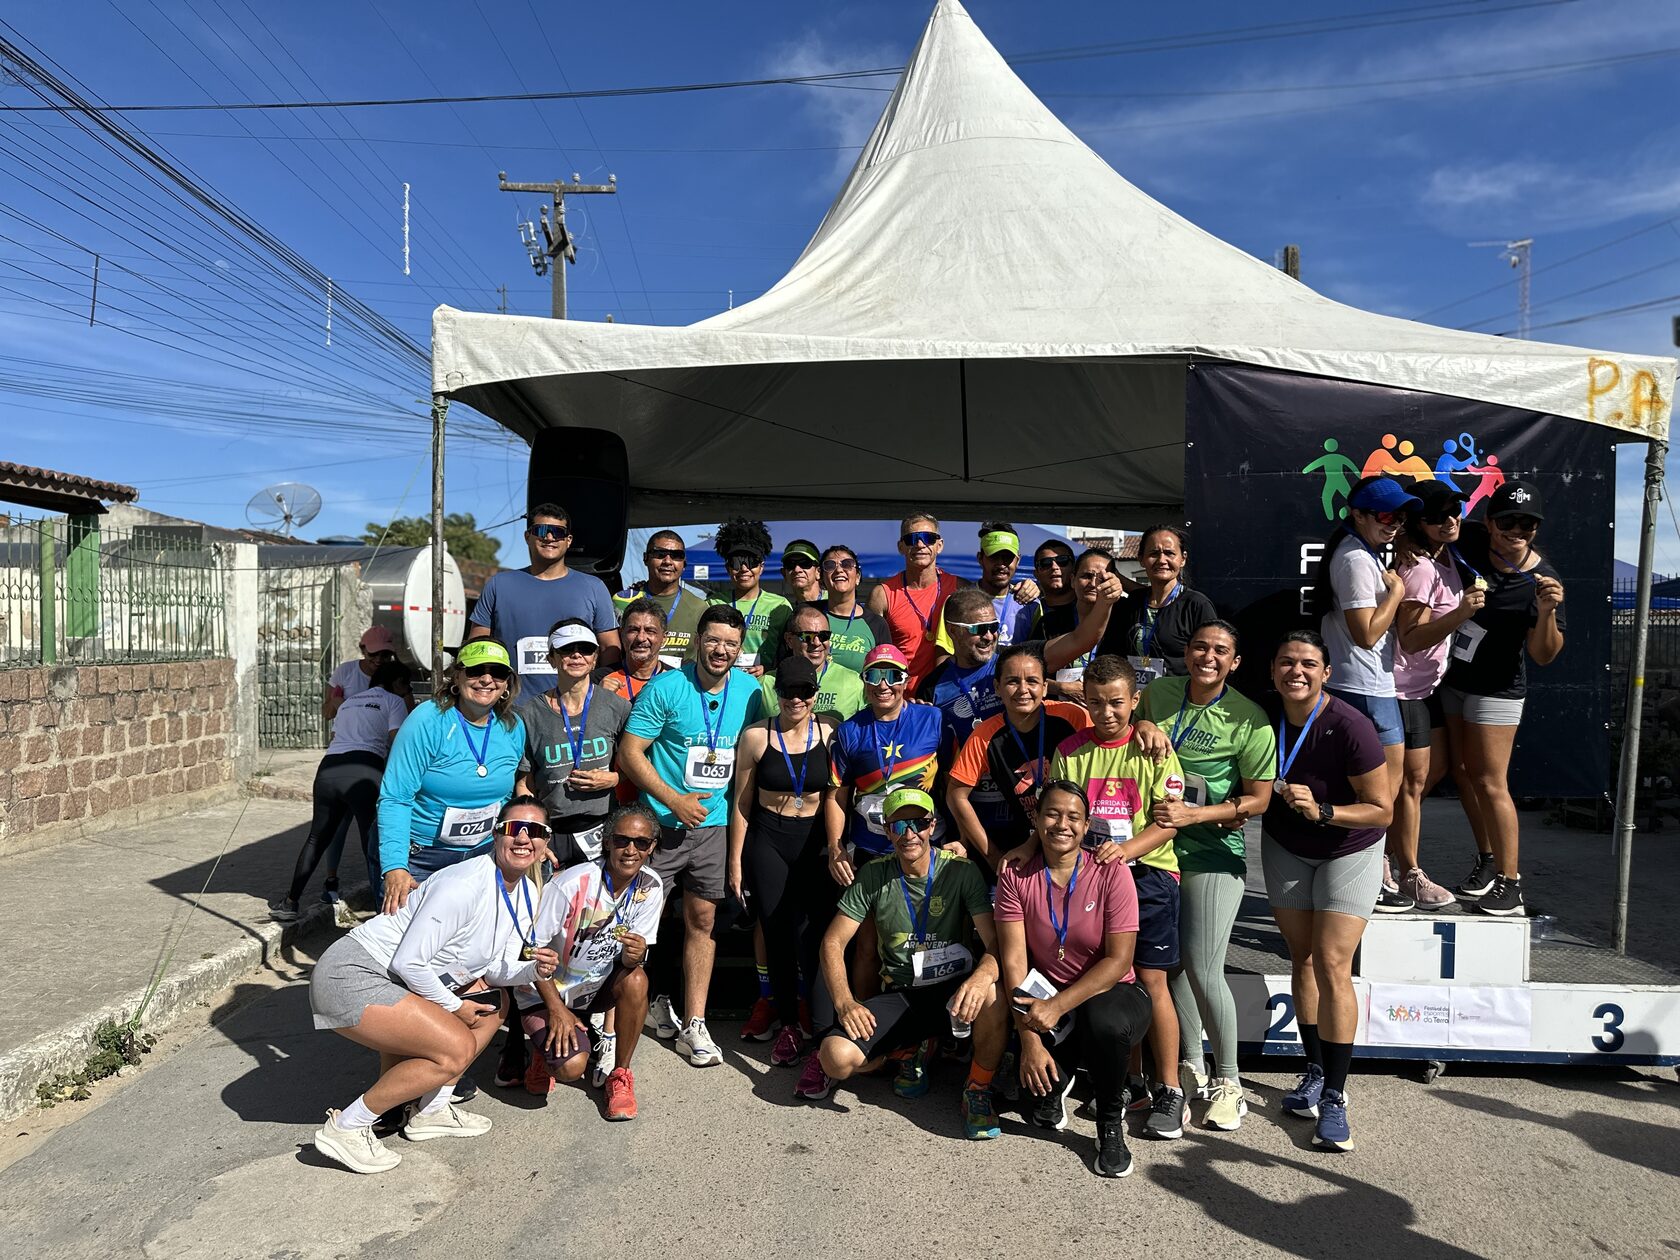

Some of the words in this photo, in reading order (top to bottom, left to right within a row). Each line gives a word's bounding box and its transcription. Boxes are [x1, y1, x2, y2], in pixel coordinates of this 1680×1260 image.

[1186, 728, 1222, 750] ORRE
[701, 765, 726, 778] 063
[1089, 806, 1133, 816] AMIZADE
[1121, 800, 1131, 808] DA
[459, 821, 486, 836] 074
[1433, 922, 1456, 979] 1
[932, 962, 955, 978] 166
[1265, 993, 1298, 1041] 2
[1591, 1003, 1625, 1052] 3
